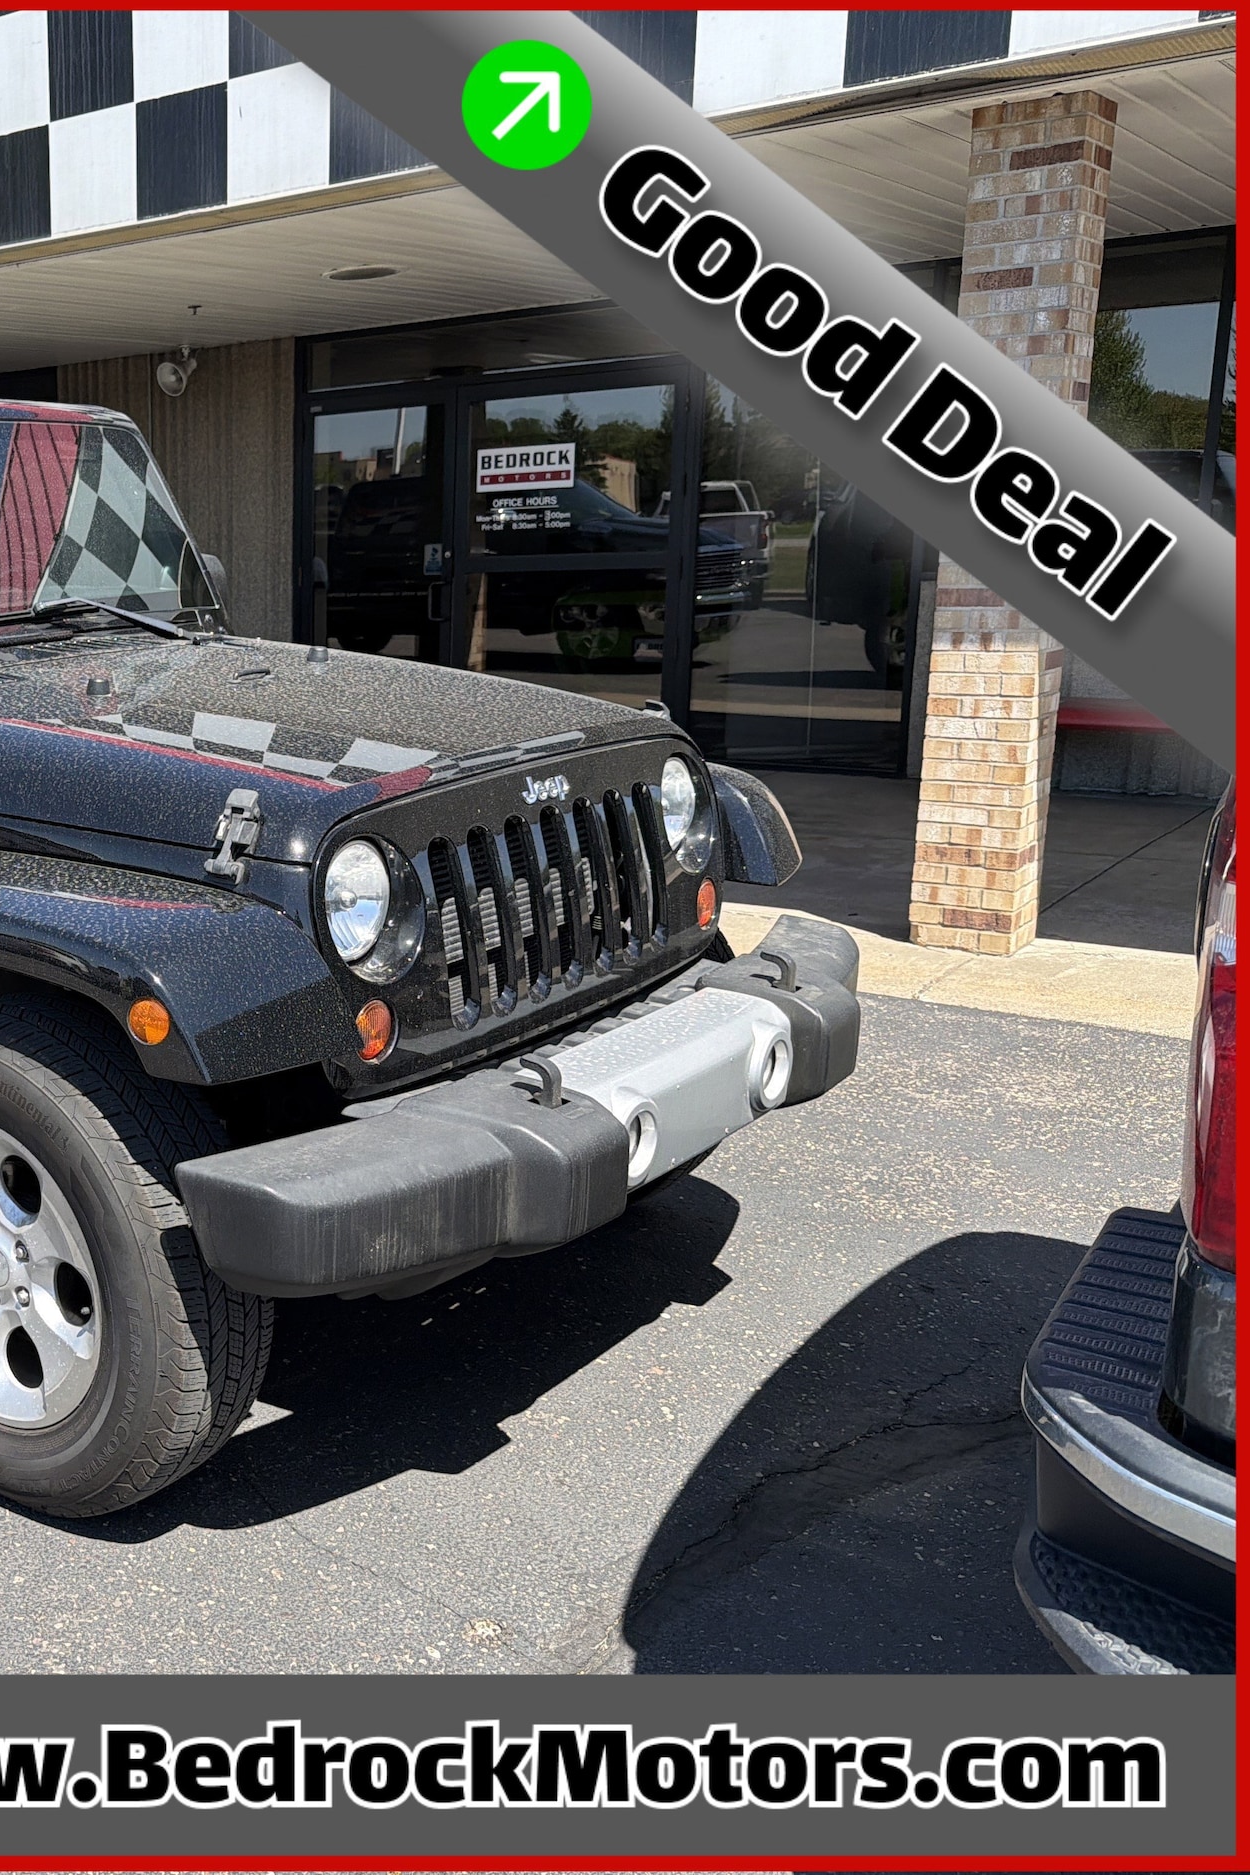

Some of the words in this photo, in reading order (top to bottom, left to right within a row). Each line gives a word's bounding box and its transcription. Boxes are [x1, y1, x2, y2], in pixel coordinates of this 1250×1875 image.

[480, 449, 570, 470] BEDROCK
[484, 472, 567, 484] MOTORS
[492, 497, 523, 508] OFFICE
[526, 496, 557, 506] HOURS
[521, 774, 571, 805] Jeep
